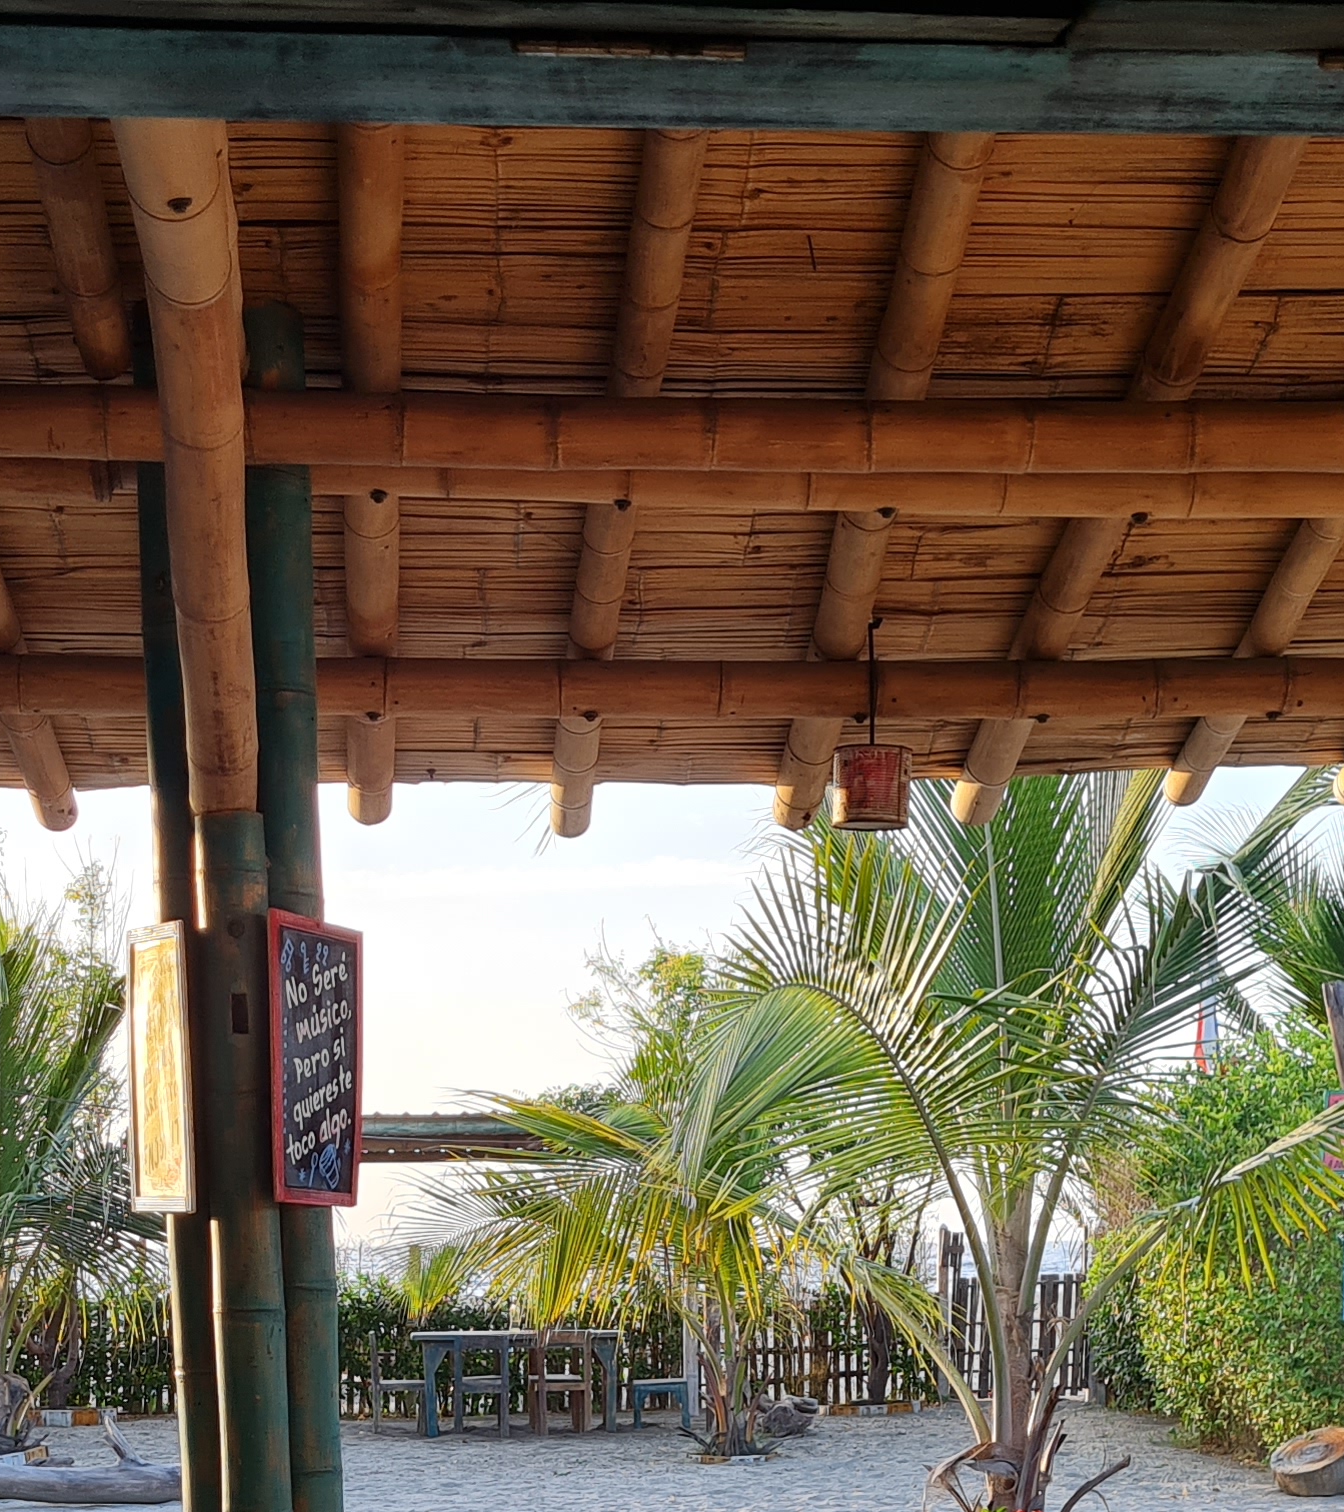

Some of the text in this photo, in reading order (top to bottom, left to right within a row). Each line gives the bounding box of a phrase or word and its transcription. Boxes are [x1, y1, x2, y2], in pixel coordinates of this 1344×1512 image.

[285, 951, 348, 1009] No Seré
[295, 998, 352, 1044] músico,
[294, 1027, 346, 1084] Pero si
[286, 1107, 352, 1165] toco algo.
